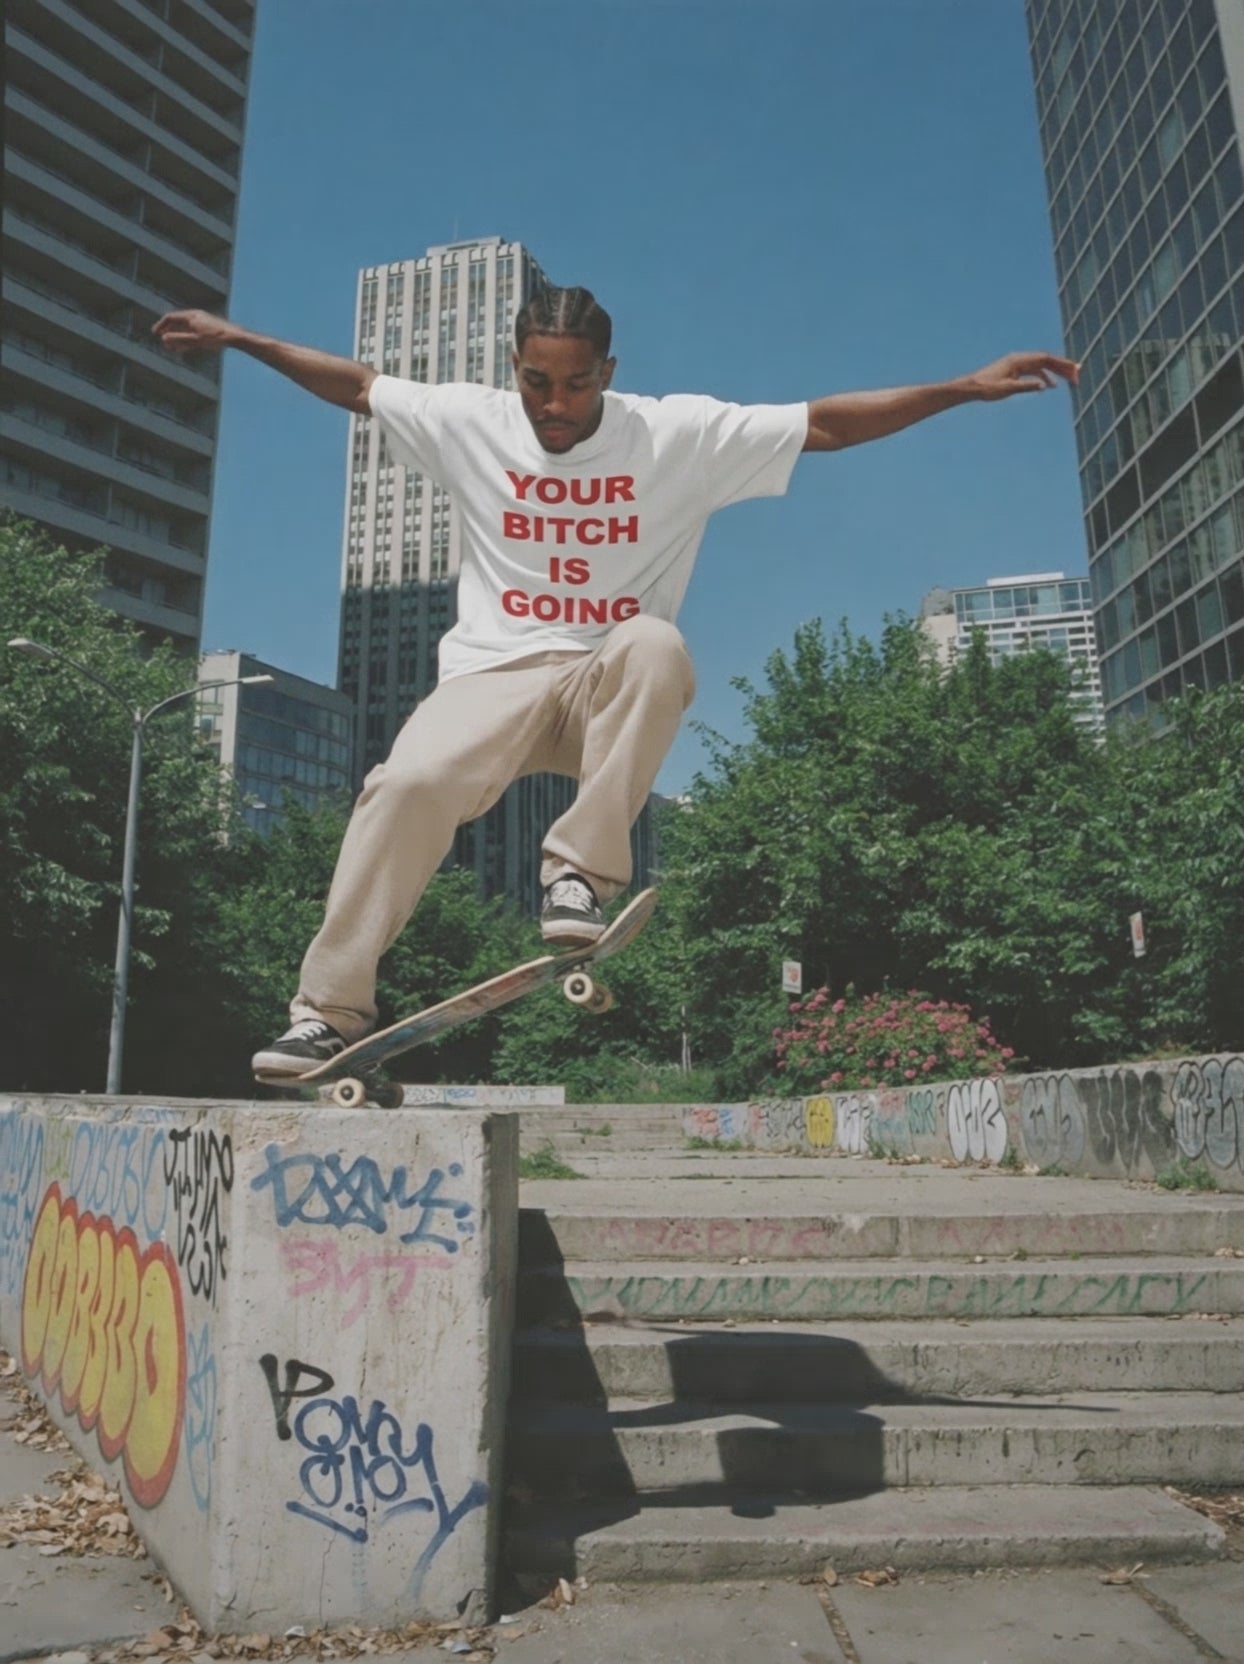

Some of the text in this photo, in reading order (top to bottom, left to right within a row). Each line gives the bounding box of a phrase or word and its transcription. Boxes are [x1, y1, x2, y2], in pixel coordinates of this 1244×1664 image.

[505, 470, 636, 506] YOUR
[503, 511, 639, 545] BITCH
[549, 557, 590, 585] IS
[502, 589, 640, 624] GOING
